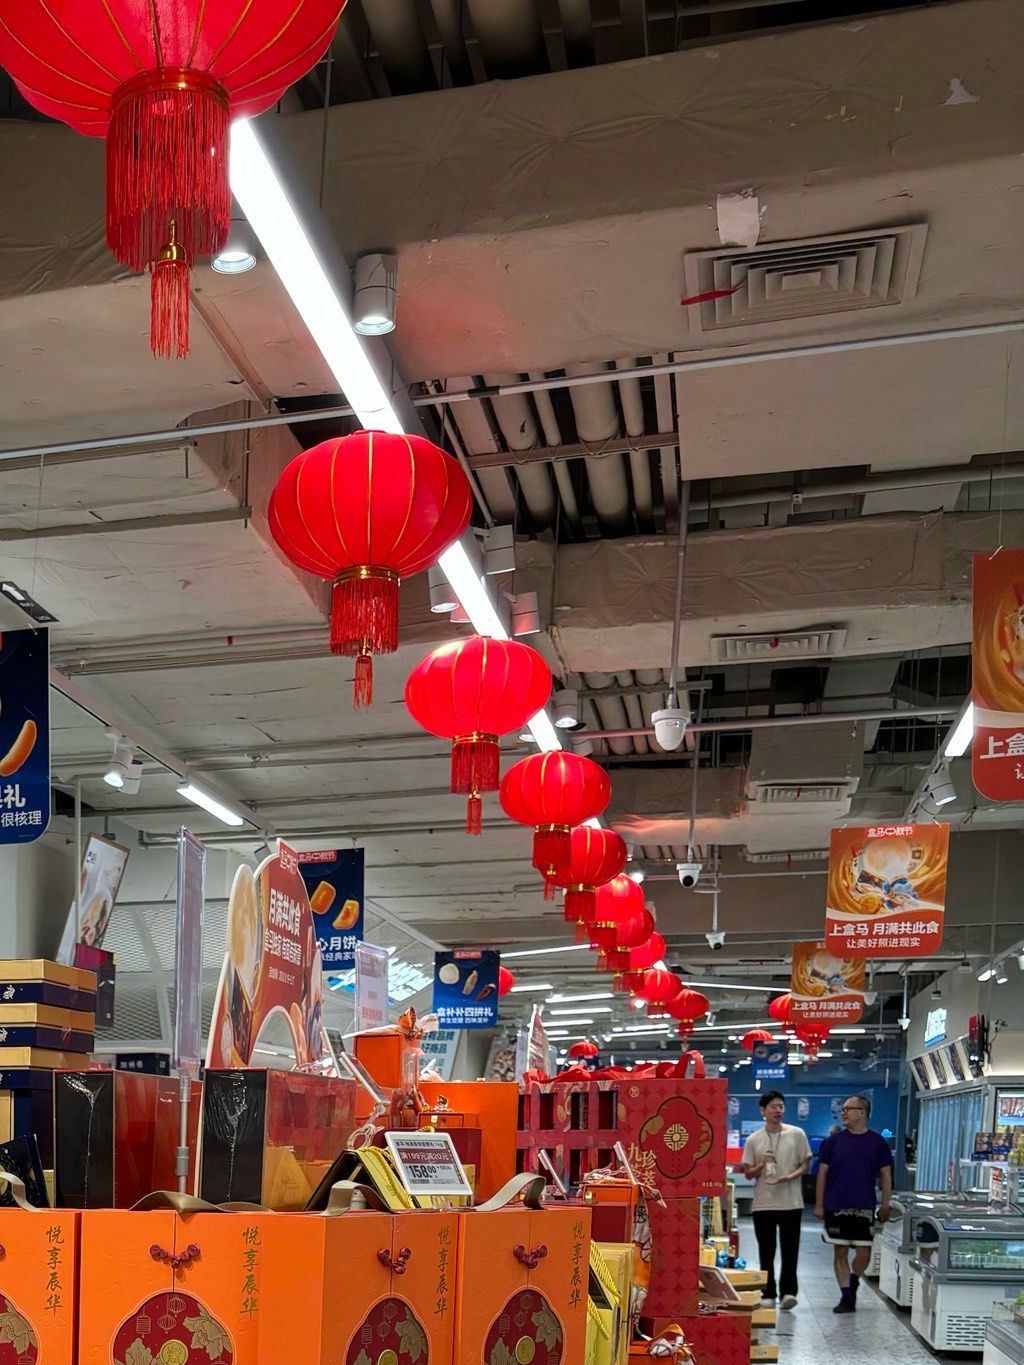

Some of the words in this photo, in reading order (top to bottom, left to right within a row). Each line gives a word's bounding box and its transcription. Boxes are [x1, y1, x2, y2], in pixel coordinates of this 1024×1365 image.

[0, 810, 42, 828] 很核理
[829, 923, 869, 937] 上盒马
[872, 920, 939, 936] 月满共此食
[846, 937, 921, 949] 让美好照进现实
[44, 1226, 65, 1317] 悦享辰华
[239, 1226, 262, 1321] 悦享辰华
